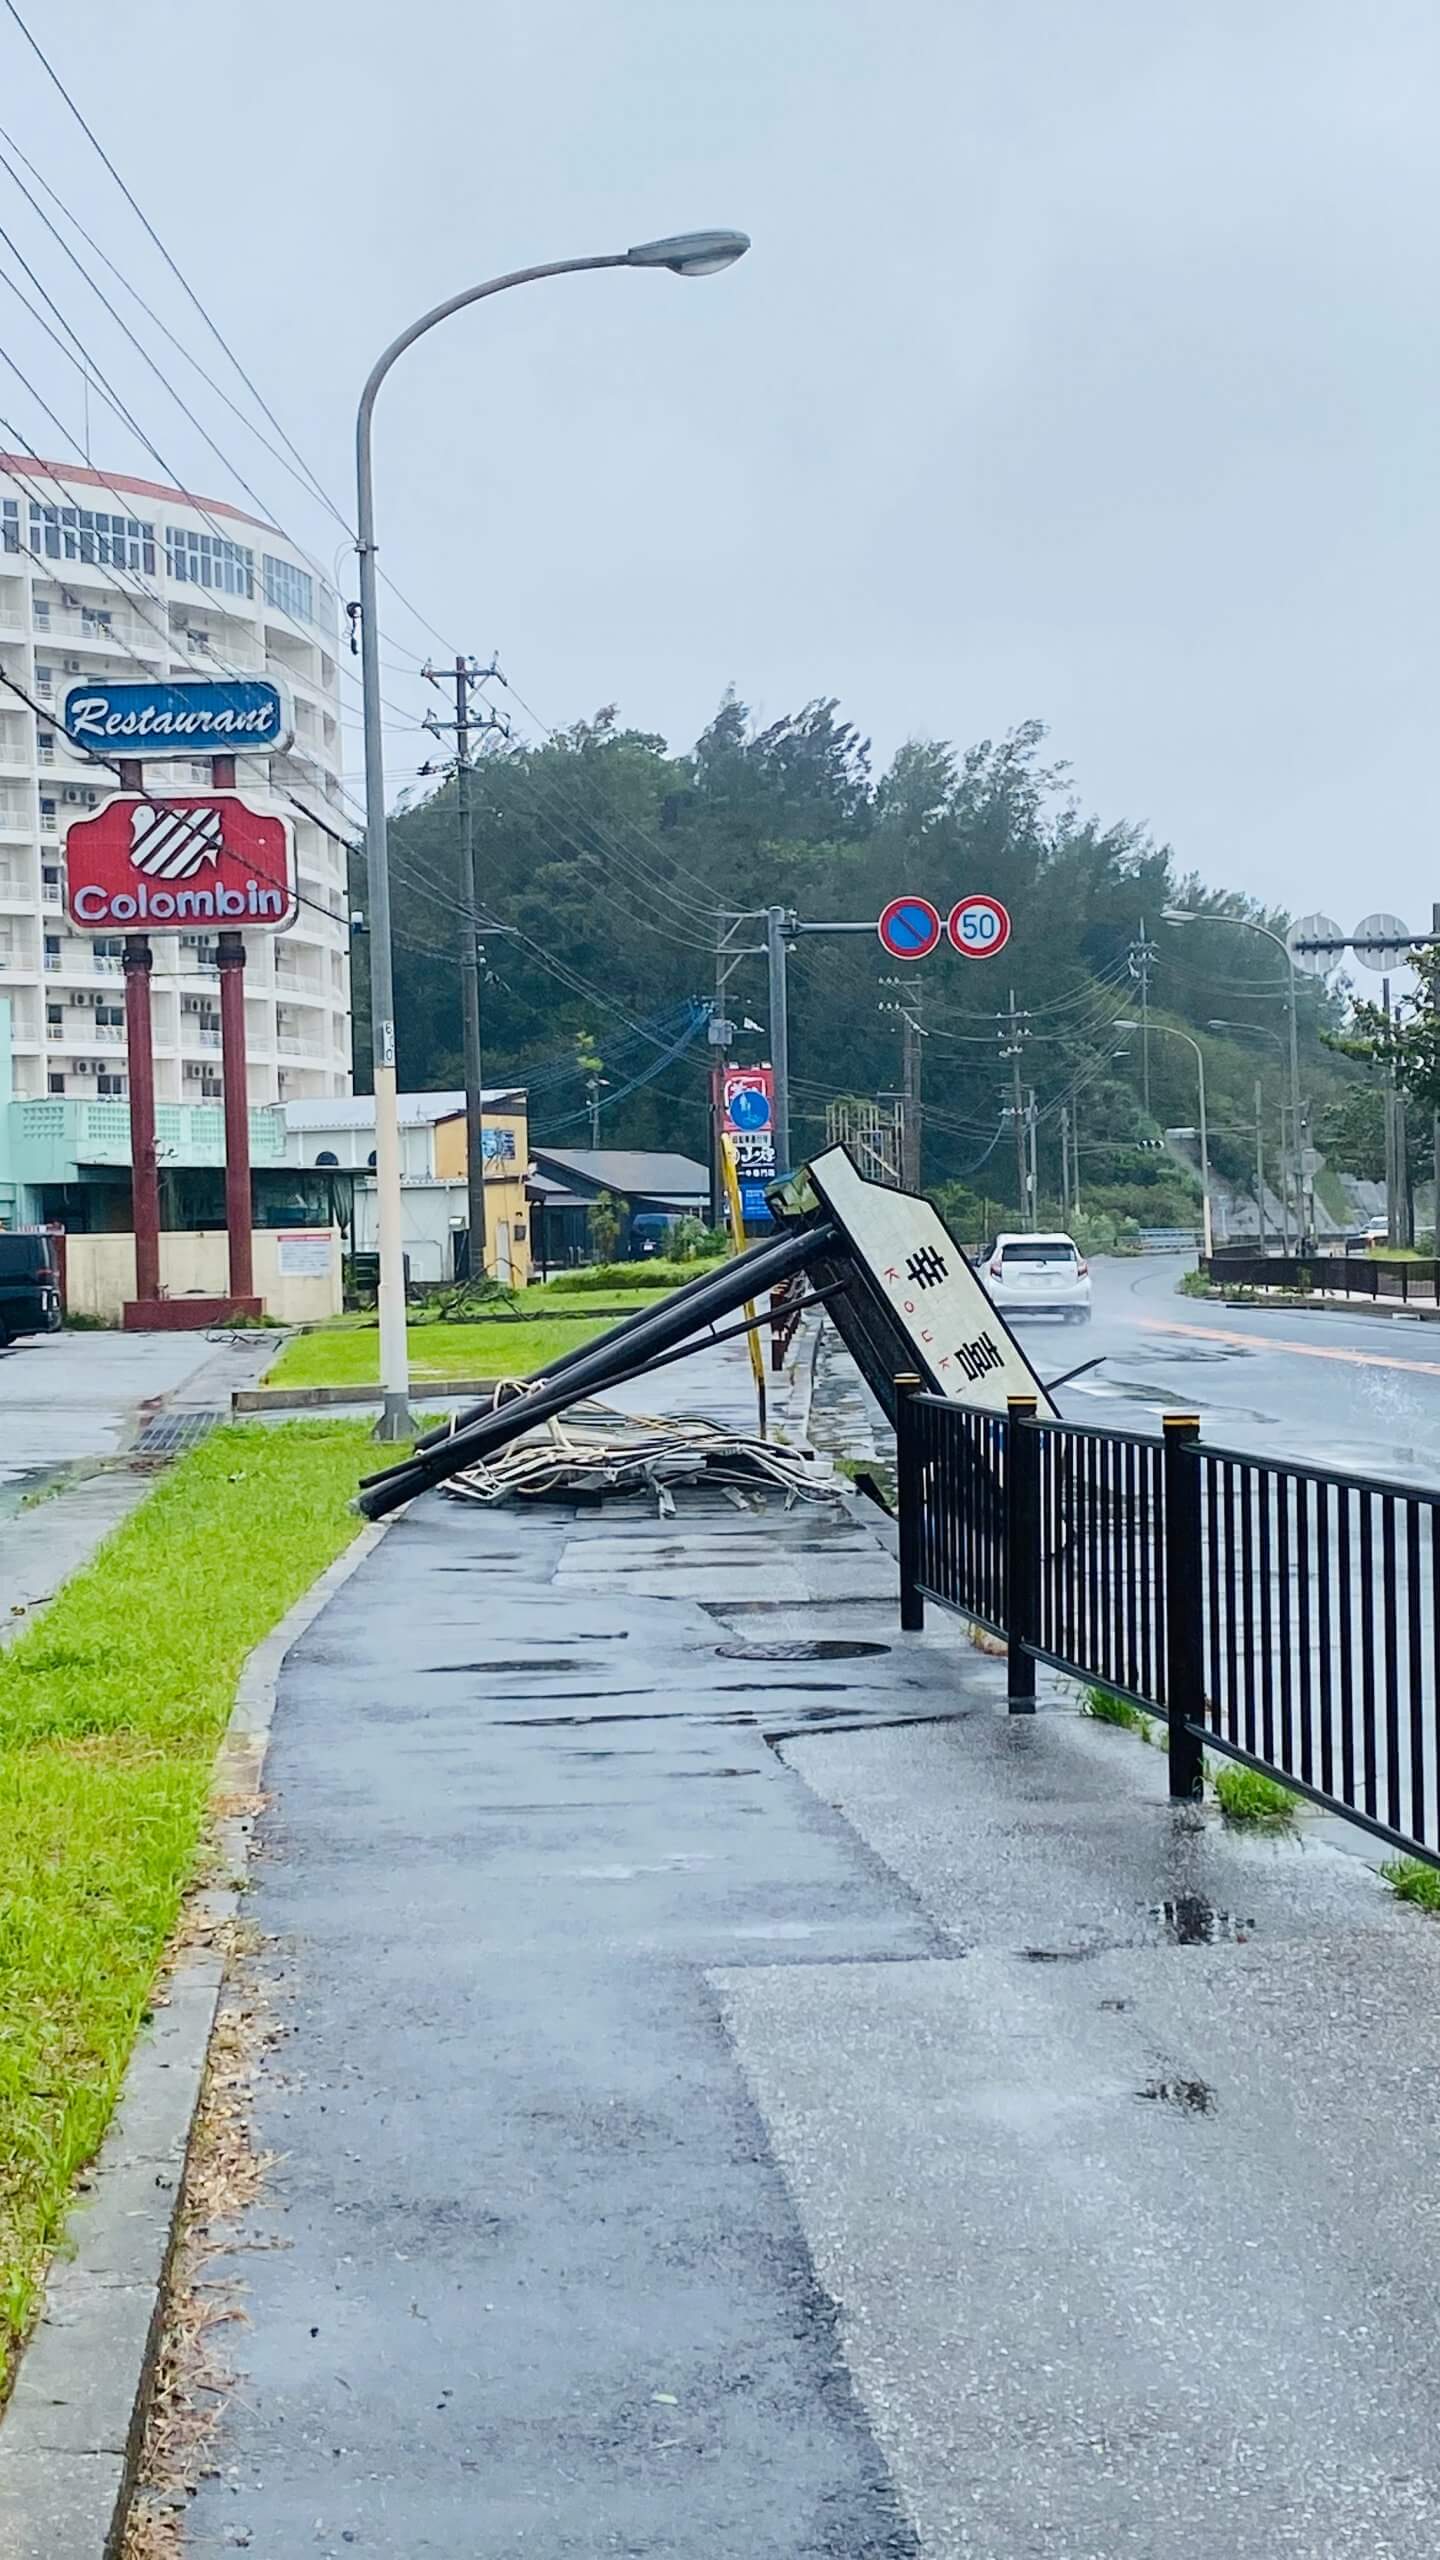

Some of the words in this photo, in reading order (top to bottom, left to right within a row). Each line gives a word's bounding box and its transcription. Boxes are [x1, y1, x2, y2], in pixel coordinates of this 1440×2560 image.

[71, 697, 275, 738] Restaurant
[74, 880, 282, 921] Colombin
[962, 913, 995, 940] 50
[905, 1245, 1005, 1382] 幸喜
